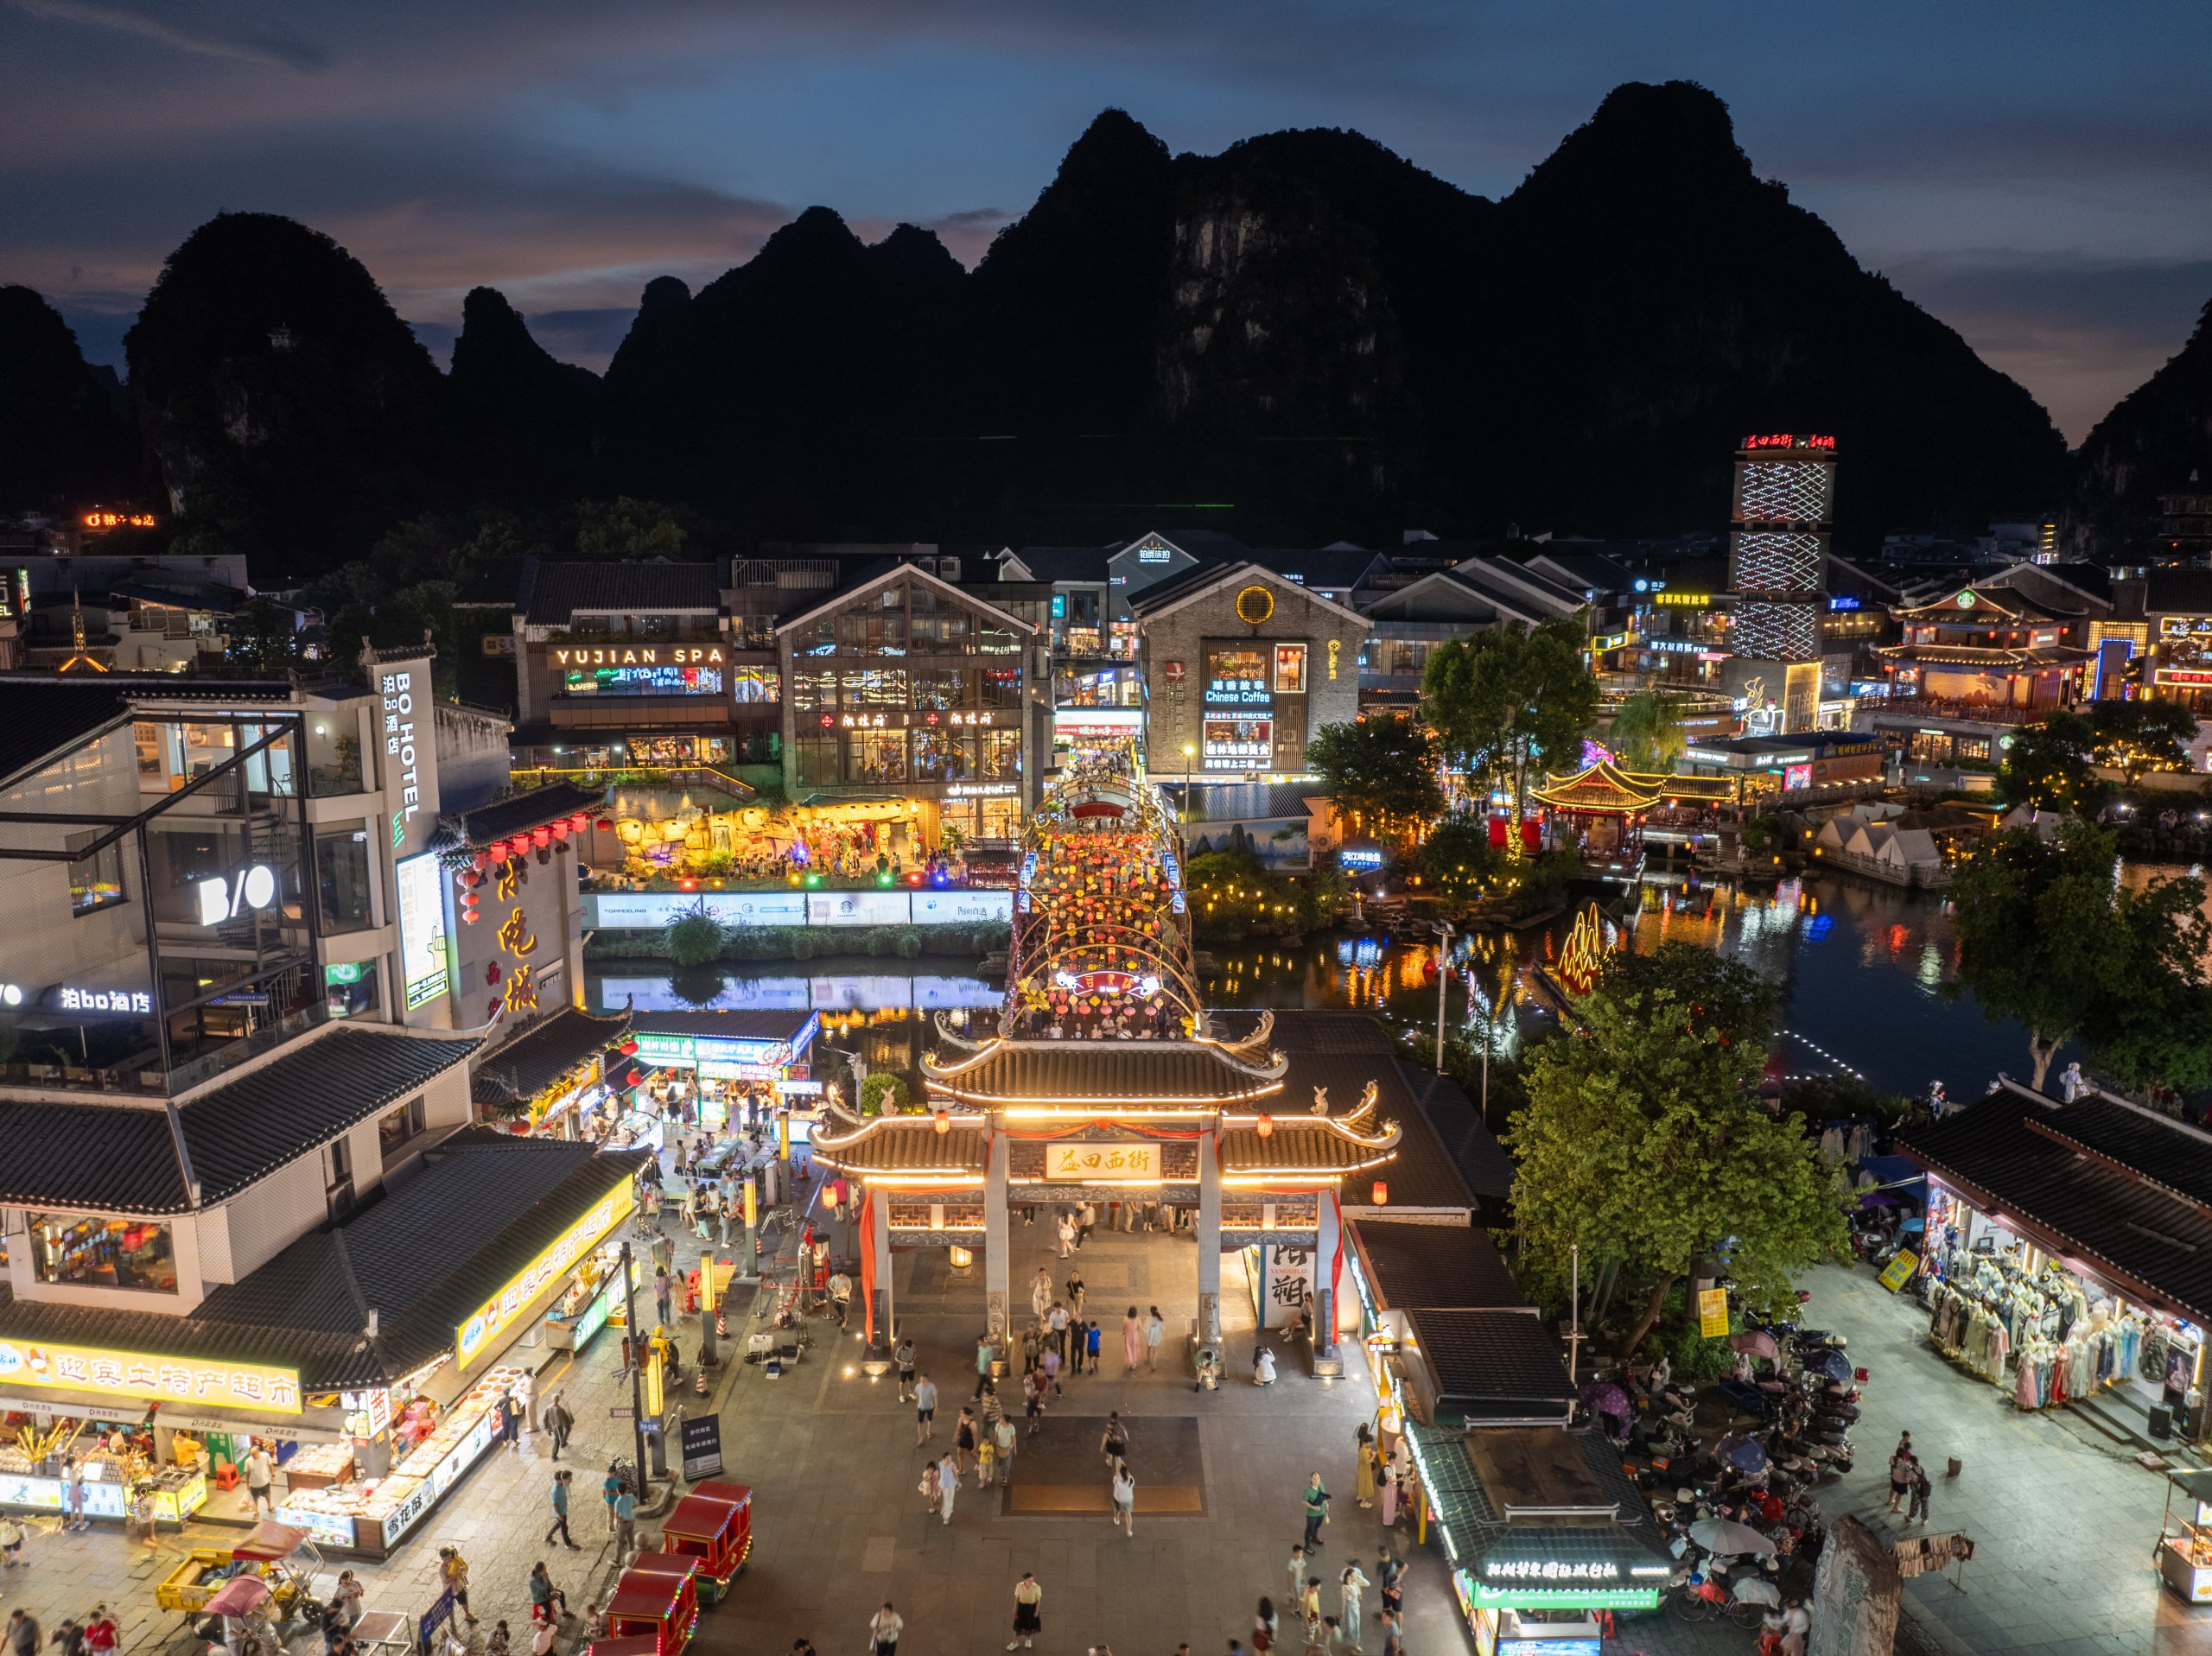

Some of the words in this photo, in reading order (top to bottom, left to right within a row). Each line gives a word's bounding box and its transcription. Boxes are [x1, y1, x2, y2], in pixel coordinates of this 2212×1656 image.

[1746, 434, 1794, 449] 益田西街
[1140, 549, 1171, 559] 铂爵旅拍
[557, 650, 656, 663] YUJIAN
[675, 649, 722, 662] SPA
[396, 672, 412, 715] BO
[1206, 691, 1239, 701] Chinese
[1242, 691, 1270, 701] Coffee
[1205, 744, 1270, 755] 桂林地标美食
[400, 723, 419, 822] HOTEL
[62, 988, 150, 1012] 泊bo酒店
[1057, 1149, 1150, 1171] 益田西街
[502, 1200, 613, 1317] 迎宾土特产超市
[1272, 1275, 1307, 1308] 朔
[55, 1355, 298, 1405] 迎宾土特产超市
[29, 1403, 52, 1412] 丹泉酒业
[96, 1409, 119, 1418] 丹泉酒业
[198, 1419, 223, 1429] 丹泉酒业
[690, 1425, 711, 1436] 步行街区
[273, 1427, 297, 1437] 丹泉酒业
[684, 1437, 717, 1450] 电动车请绕行
[387, 1493, 423, 1539] 雪花酥
